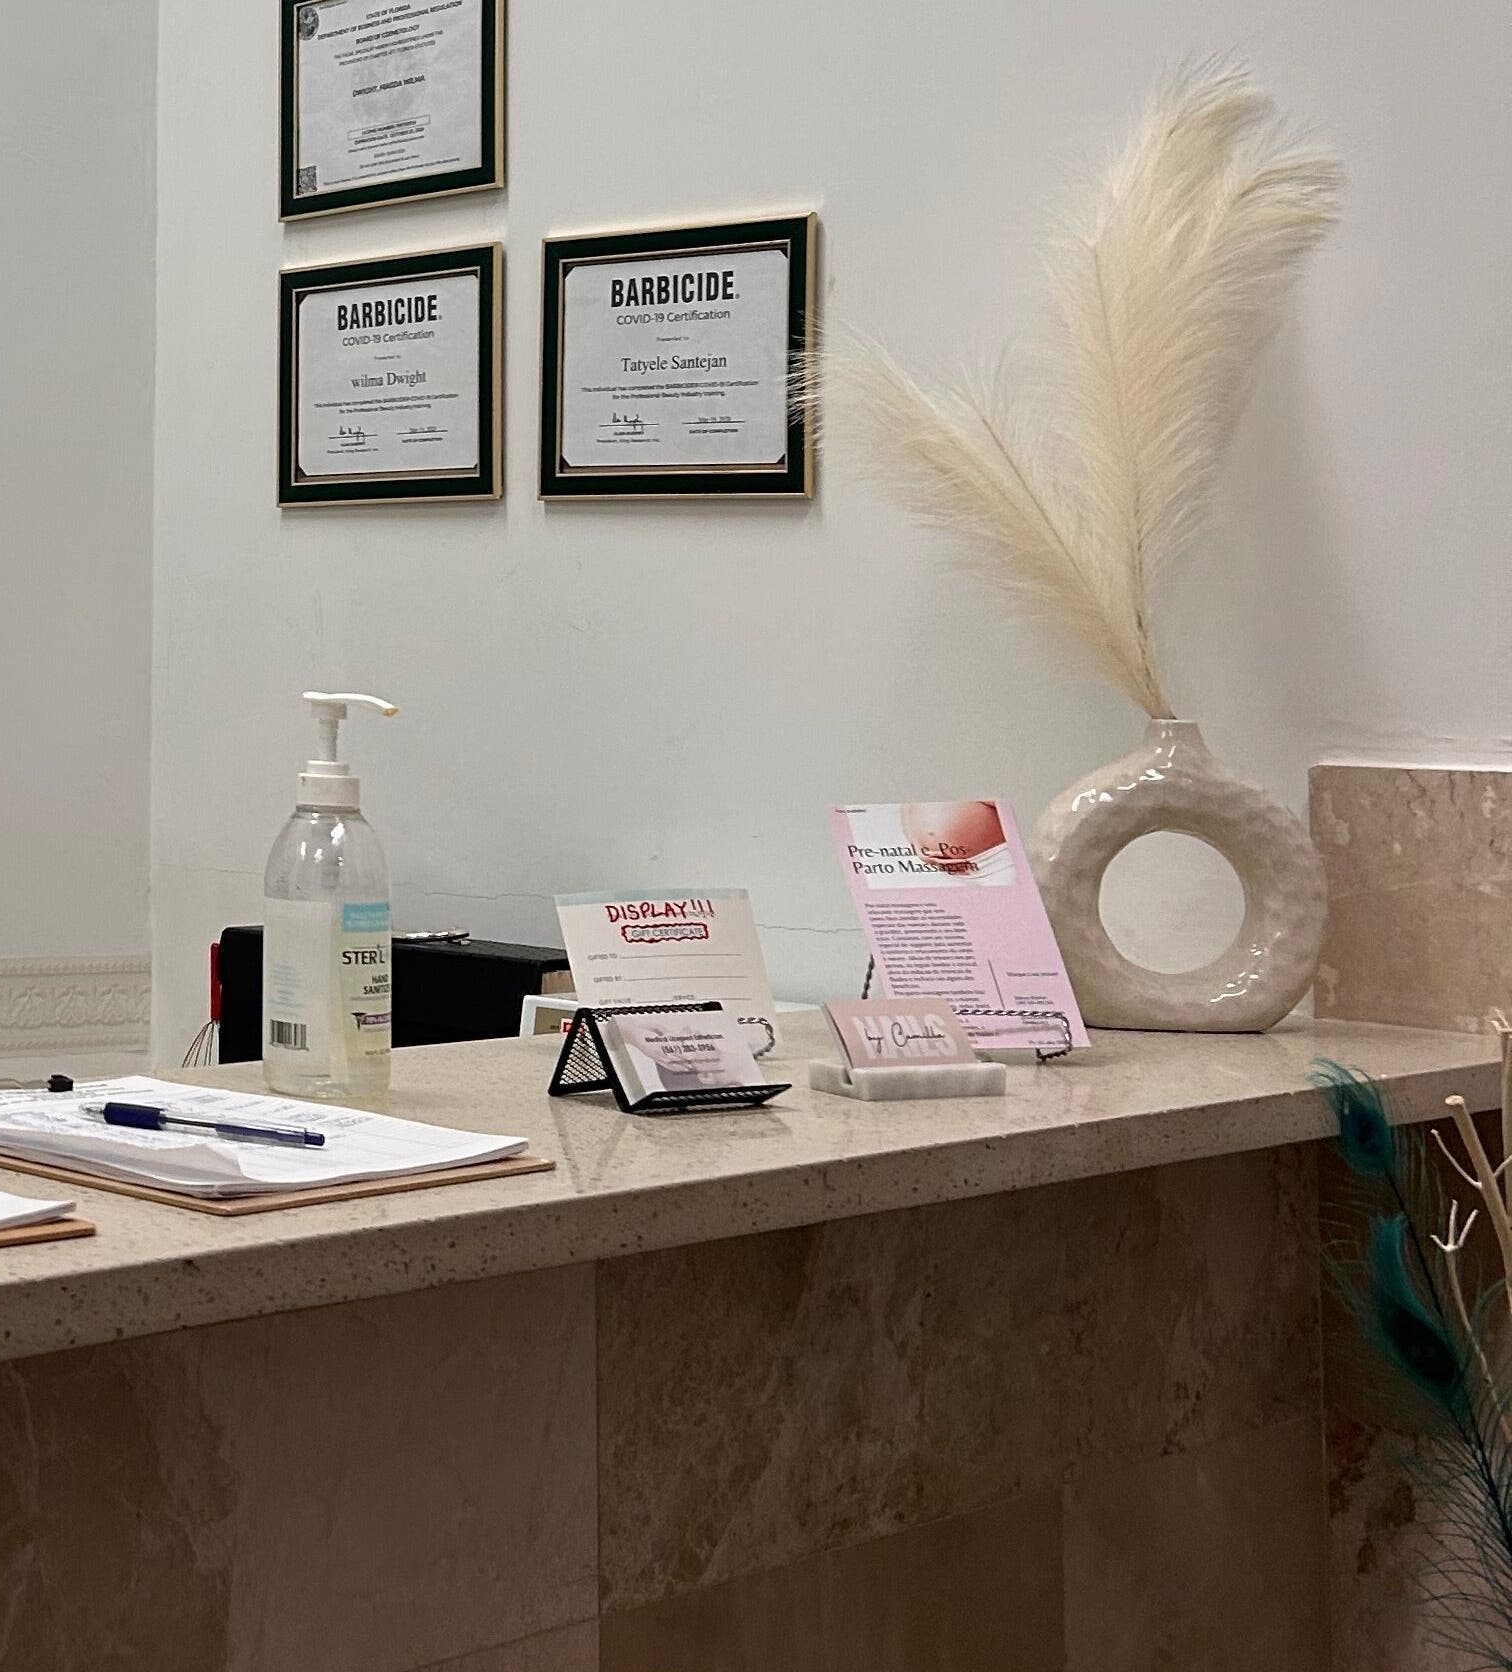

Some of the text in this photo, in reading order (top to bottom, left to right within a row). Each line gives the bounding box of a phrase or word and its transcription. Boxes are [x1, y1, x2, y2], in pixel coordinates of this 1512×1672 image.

[616, 309, 731, 326] COVID-19 Certification
[382, 330, 435, 343] Certification
[621, 353, 728, 376] Tatyele Santejan
[386, 369, 427, 388] Dwight
[848, 843, 918, 858] Pre-natal
[852, 860, 979, 876] Parto Massagem
[605, 899, 716, 923] DISPLAY!!!
[652, 927, 703, 938] CERTIFICATE
